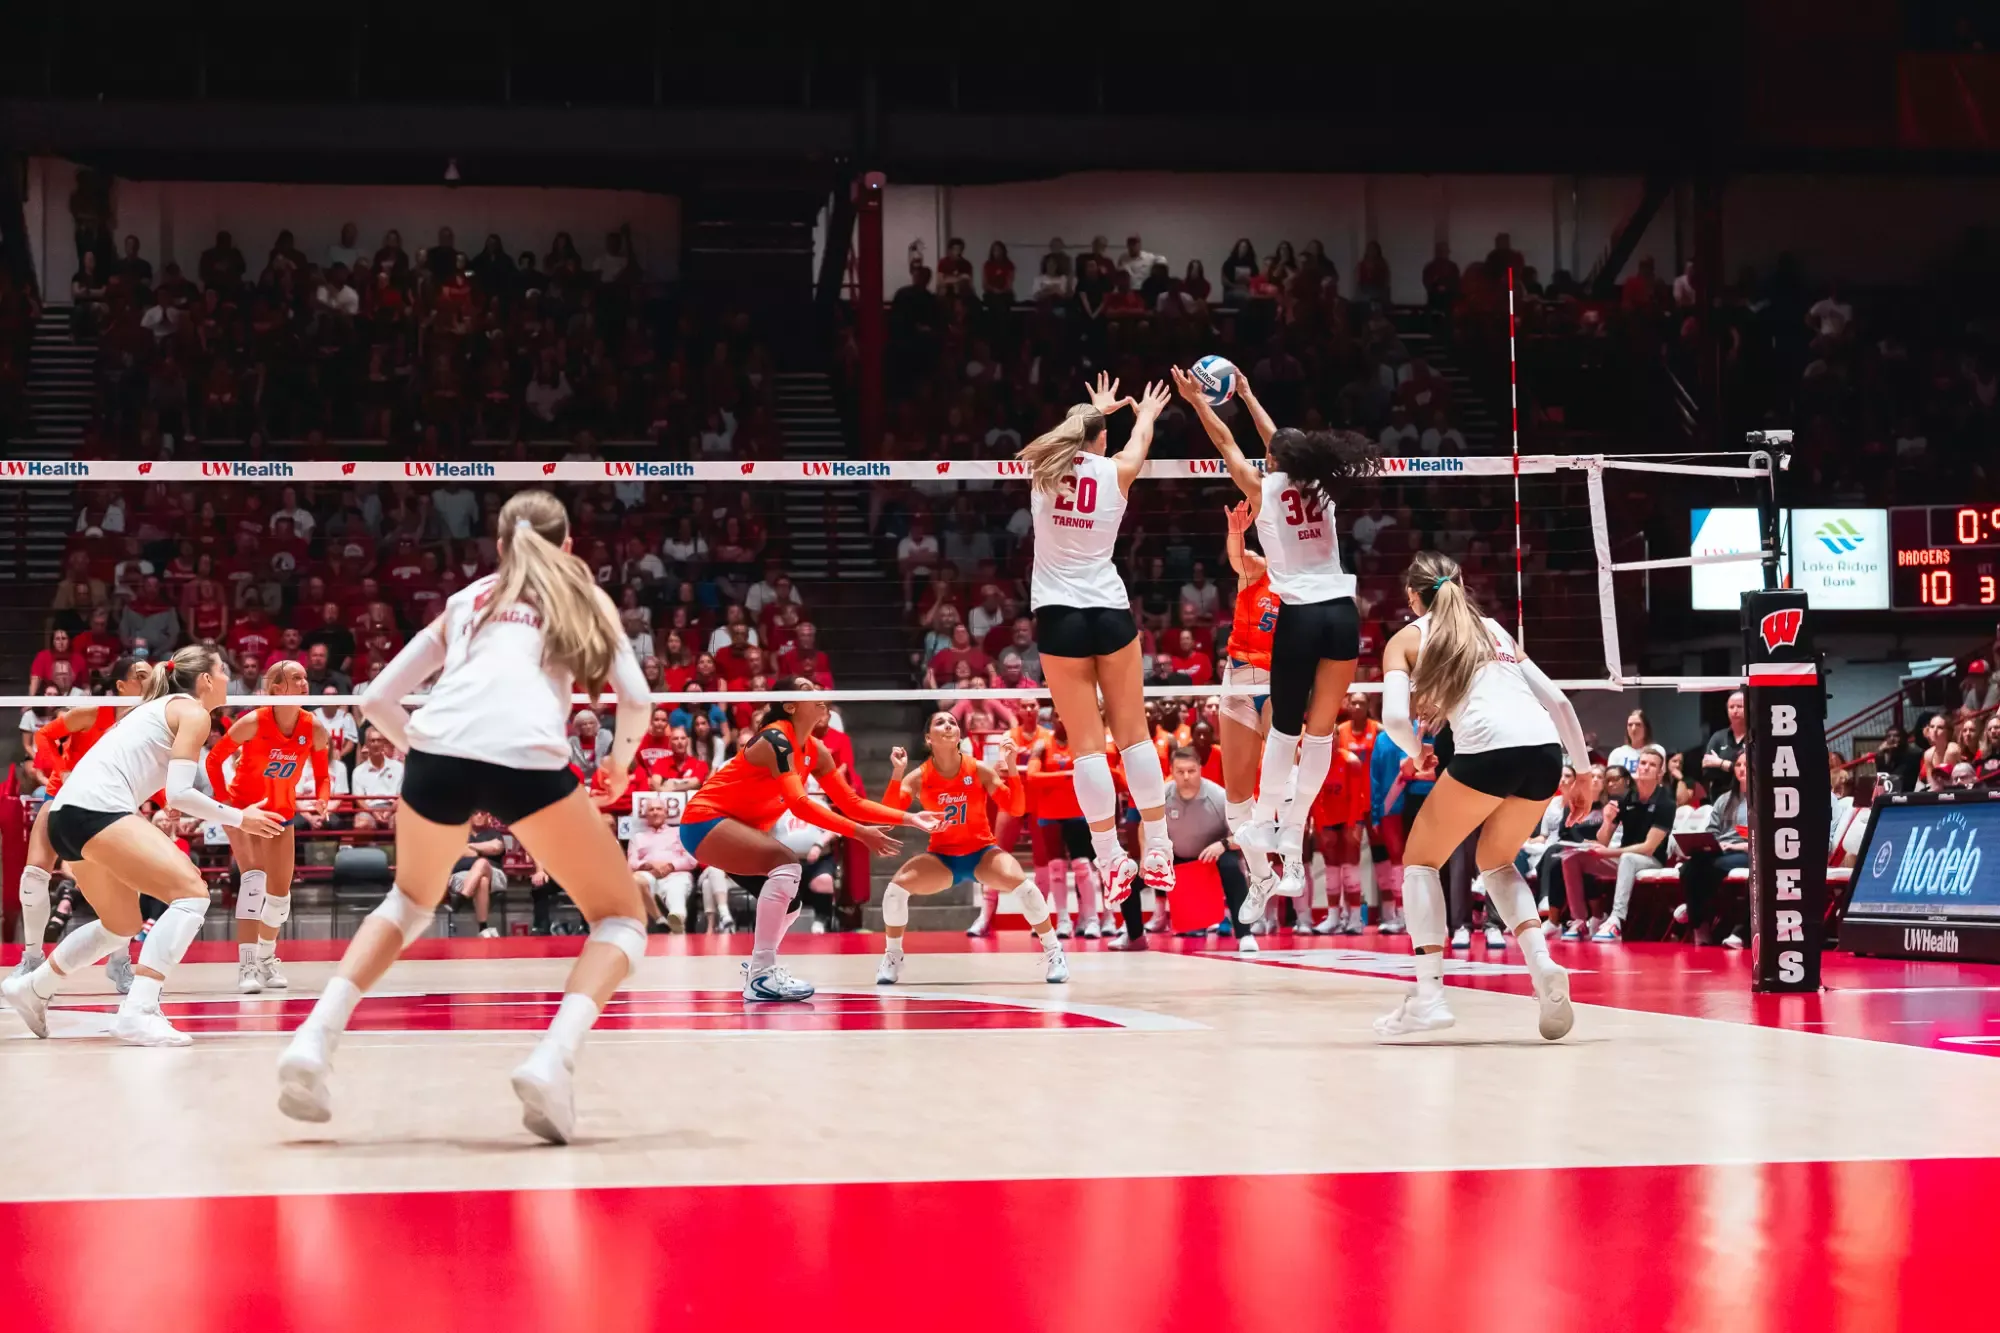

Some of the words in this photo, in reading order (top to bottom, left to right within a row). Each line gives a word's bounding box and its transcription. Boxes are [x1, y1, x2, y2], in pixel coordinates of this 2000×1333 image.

[1194, 366, 1216, 387] molten
[1055, 475, 1098, 514] 20
[1281, 488, 1323, 526] 32
[1052, 515, 1095, 530] TARNOW
[1298, 528, 1322, 540] EGAN
[1802, 561, 1834, 572] Lake
[1838, 561, 1878, 574] Ridge
[1898, 549, 1950, 566] BADGERS
[1823, 576, 1856, 587] Bank
[1921, 571, 1952, 605] 10
[1980, 576, 1995, 603] 3
[1258, 611, 1279, 632] 5
[263, 760, 298, 779] 20
[943, 803, 968, 825] 21
[1770, 704, 1806, 984] BADGERS
[1891, 826, 1981, 895] Modelo
